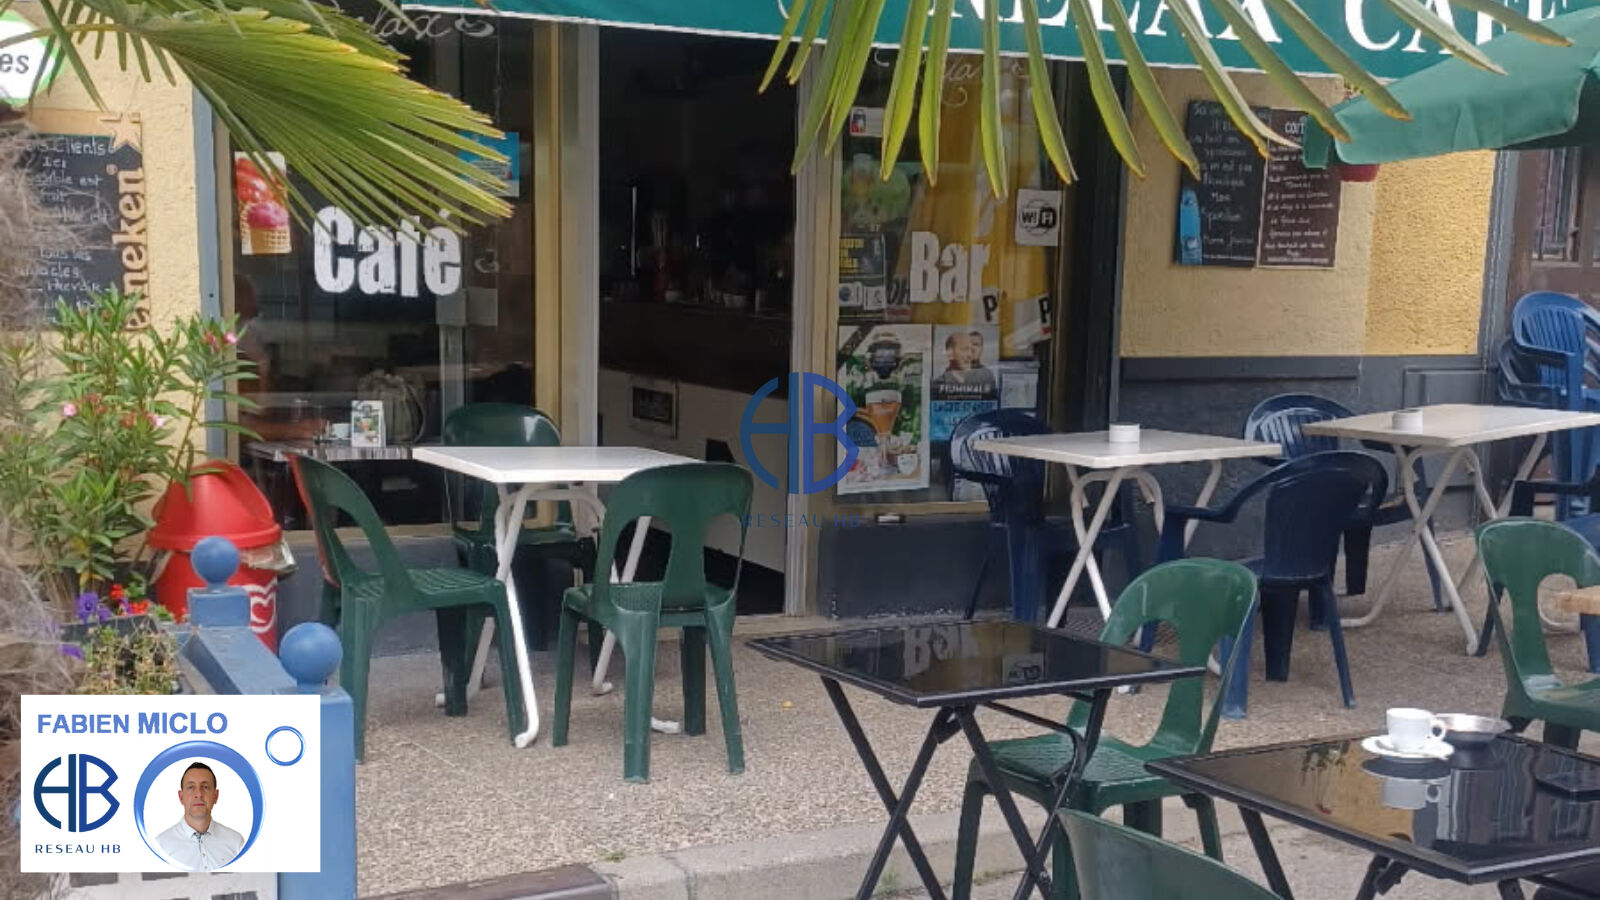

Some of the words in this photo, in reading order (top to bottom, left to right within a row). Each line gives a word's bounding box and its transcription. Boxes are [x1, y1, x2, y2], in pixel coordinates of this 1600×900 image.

[925, 0, 1283, 43] LAX
[1344, 0, 1568, 54] CA
[312, 205, 461, 298] Café
[910, 231, 990, 303] Bar
